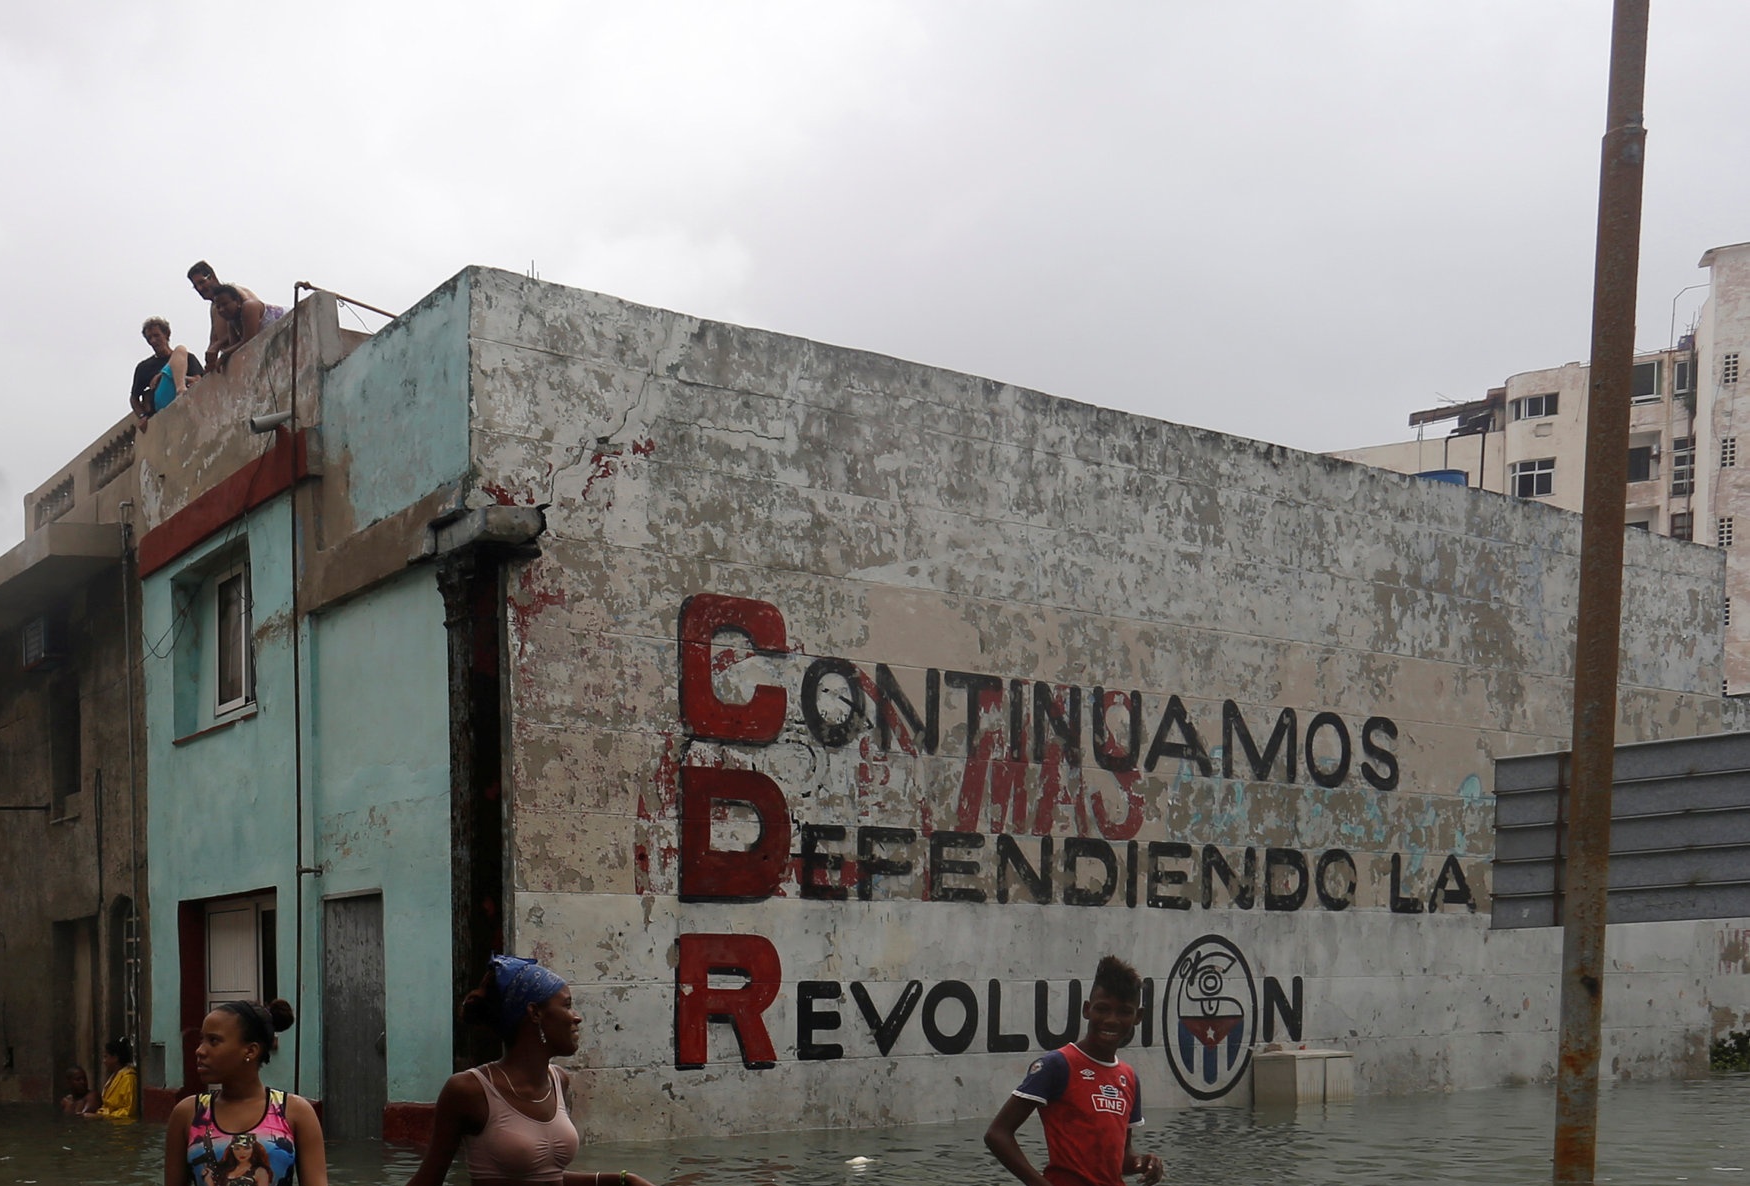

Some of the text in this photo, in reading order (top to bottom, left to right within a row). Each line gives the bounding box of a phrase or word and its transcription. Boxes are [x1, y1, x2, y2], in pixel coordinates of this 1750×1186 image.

[678, 765, 1358, 913] DEFENDIENDO
[1391, 852, 1477, 914] LA
[1097, 1098, 1122, 1110] TINE
